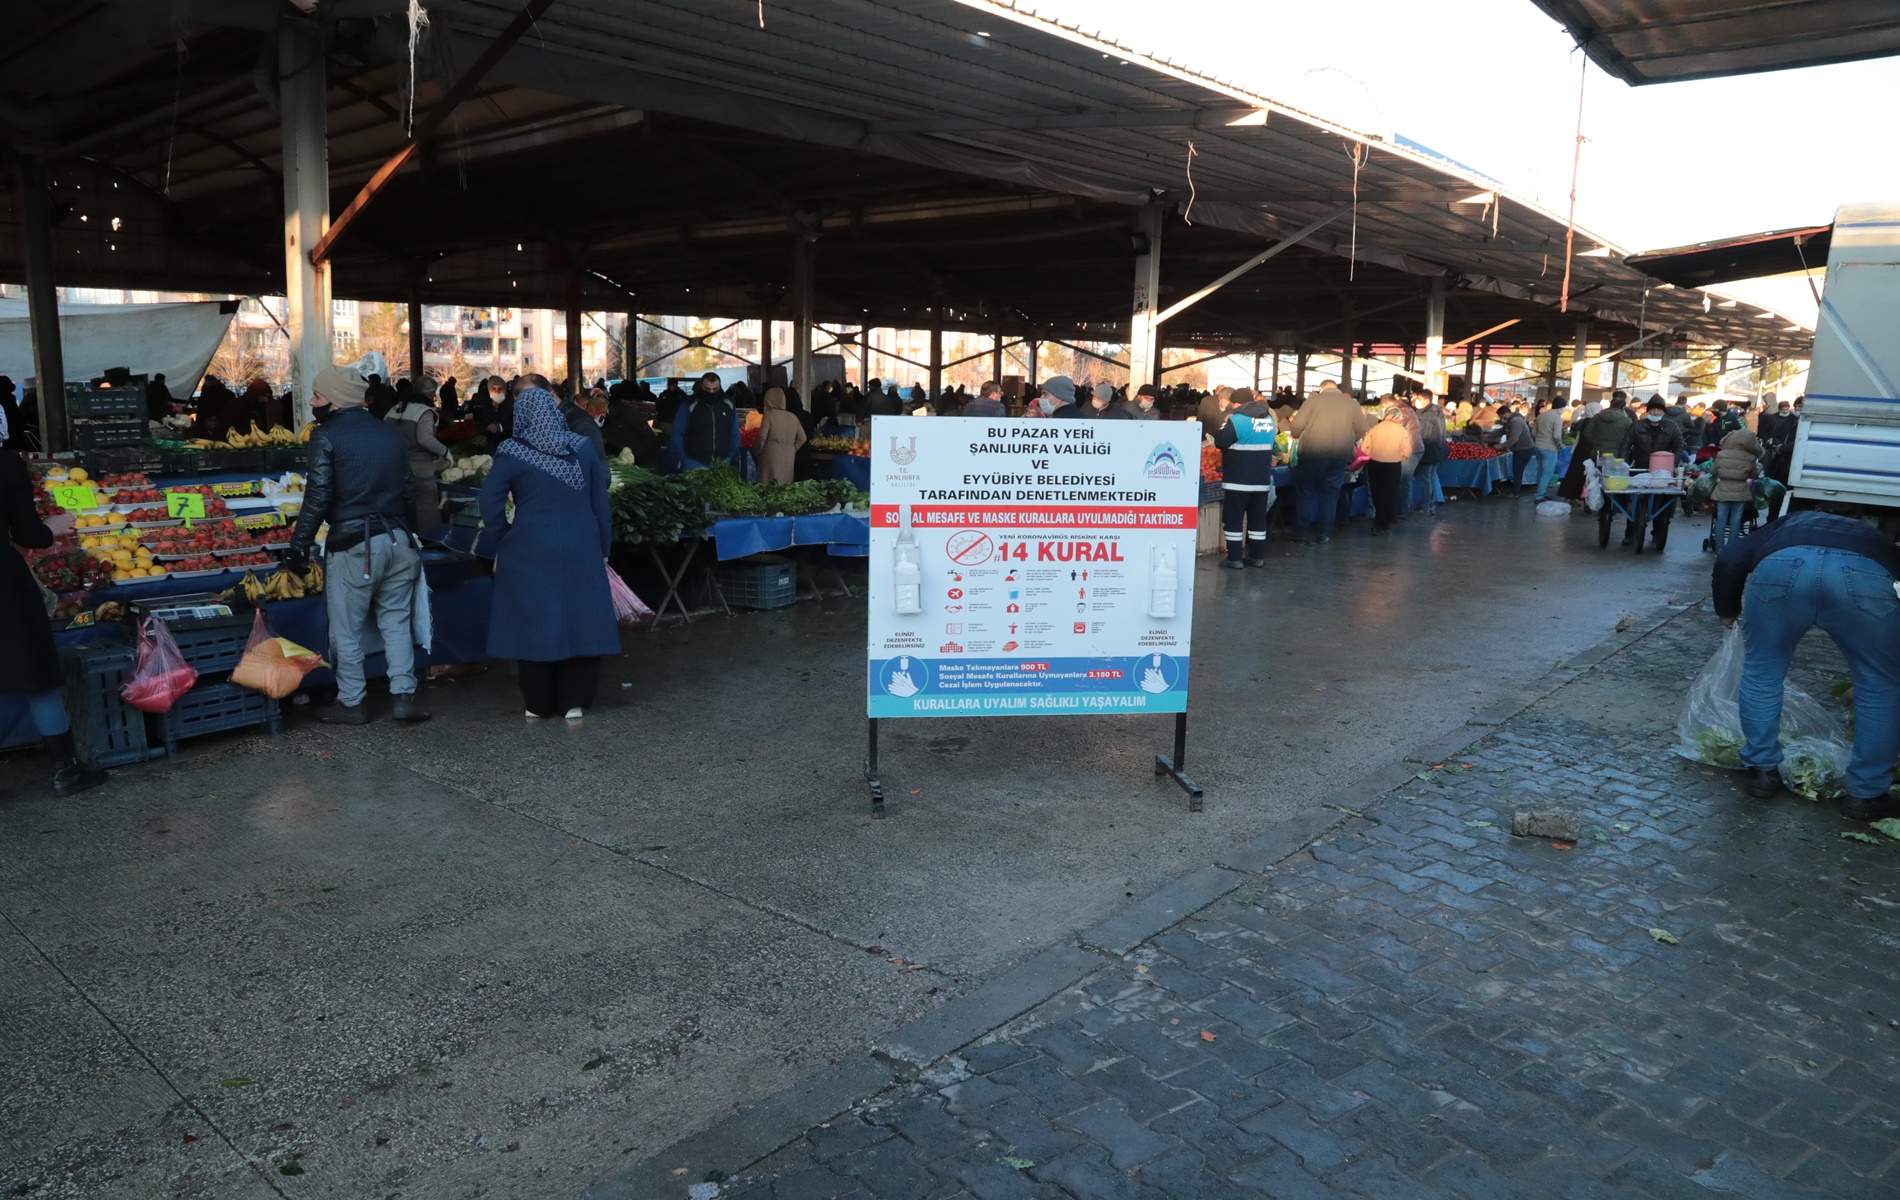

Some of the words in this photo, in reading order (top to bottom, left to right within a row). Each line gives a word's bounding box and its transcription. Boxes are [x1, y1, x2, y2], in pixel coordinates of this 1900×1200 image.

[988, 428, 1007, 438] BU
[1012, 428, 1059, 438] PAZAR
[1063, 427, 1094, 439] YERİ
[969, 443, 1049, 456] ŞANLIURFA
[1053, 442, 1111, 455] VALİLİĞİ
[1031, 459, 1049, 470] VE
[963, 473, 1033, 485] EYYÜBİYE
[1037, 473, 1115, 486] BELEDİYESİ
[62, 487, 79, 507] 8
[919, 489, 1012, 500] TARAFINDAN
[1016, 489, 1156, 502] DENETLENMEKTEDİR
[175, 496, 190, 516] 7
[885, 511, 924, 524] SOAL
[927, 511, 965, 524] MESAFE
[968, 512, 980, 524] VE
[982, 512, 1016, 524] MASKE
[1019, 512, 1075, 525] KURALLARA
[1077, 510, 1136, 525] UYULMADIĞI
[1139, 511, 1183, 525] TAKTİRDE
[1038, 542, 1124, 562] KURAL
[966, 664, 1019, 672] Takmayanlara
[939, 672, 964, 681] Sosyal
[966, 672, 994, 680] Mesafe
[1039, 672, 1087, 680] Uymayanlara
[939, 681, 960, 689] Cezai
[961, 680, 982, 689] İşlem
[984, 680, 1044, 690] Uygulanacaktır.
[913, 698, 981, 710] KURALLARA
[984, 697, 1027, 709] UYALIM
[1030, 694, 1079, 708] SAĞLIKLI
[1082, 695, 1146, 711] YAŞAYALIM
